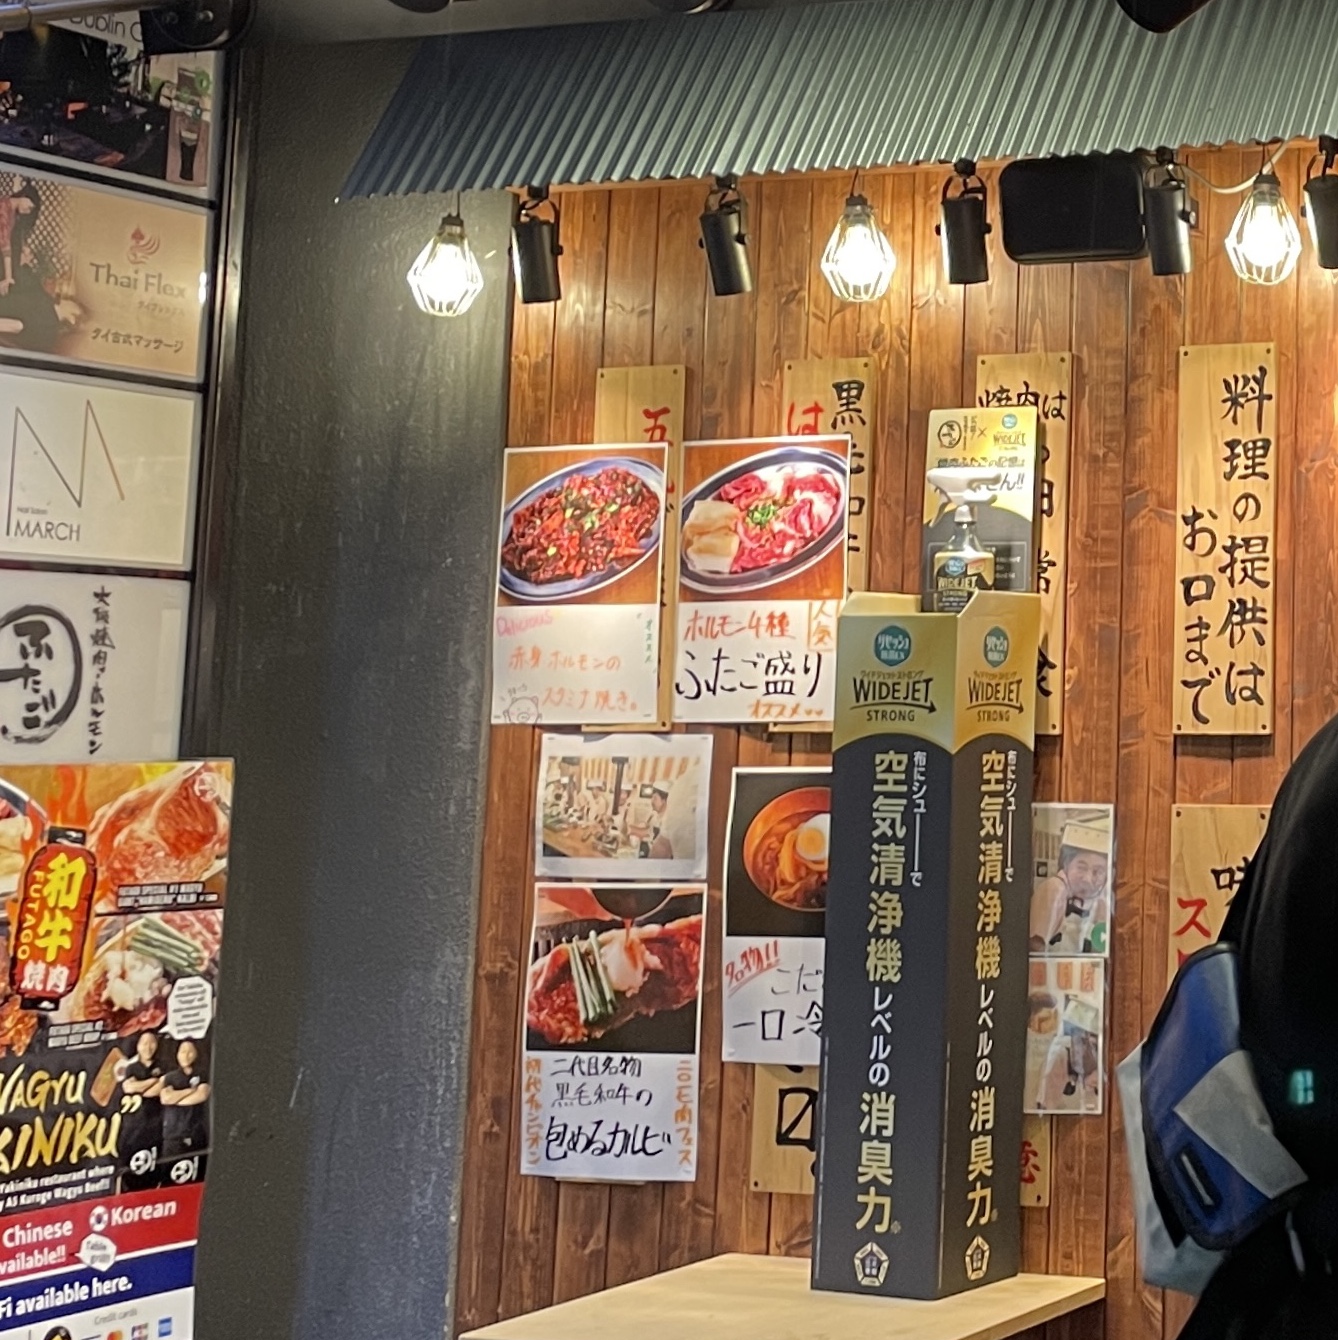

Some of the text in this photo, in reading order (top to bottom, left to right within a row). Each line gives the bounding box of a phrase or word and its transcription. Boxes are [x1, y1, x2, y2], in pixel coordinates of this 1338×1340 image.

[89, 262, 186, 299] Thai Flex
[14, 519, 81, 542] MARCH
[1216, 364, 1274, 707] 料理の提供は
[1179, 504, 1221, 725] お口まで
[675, 647, 823, 701] ふたご盛り
[853, 677, 935, 703] WIDEJET
[968, 677, 1023, 704] WIDEJET
[866, 709, 916, 722] STRONG
[977, 709, 1010, 723] STRONG
[17, 869, 46, 961] FUTAGO
[34, 852, 88, 963] 和牛
[20, 959, 71, 993] 焼肉
[550, 1054, 642, 1078] 二代目名物
[551, 1081, 653, 1108] 黒毛和牛の
[545, 1115, 672, 1162] 包めるカルビ
[110, 1200, 178, 1227] Korean
[2, 1219, 74, 1249] Chinese
[16, 1278, 90, 1317] available
[92, 1274, 133, 1298] here.
